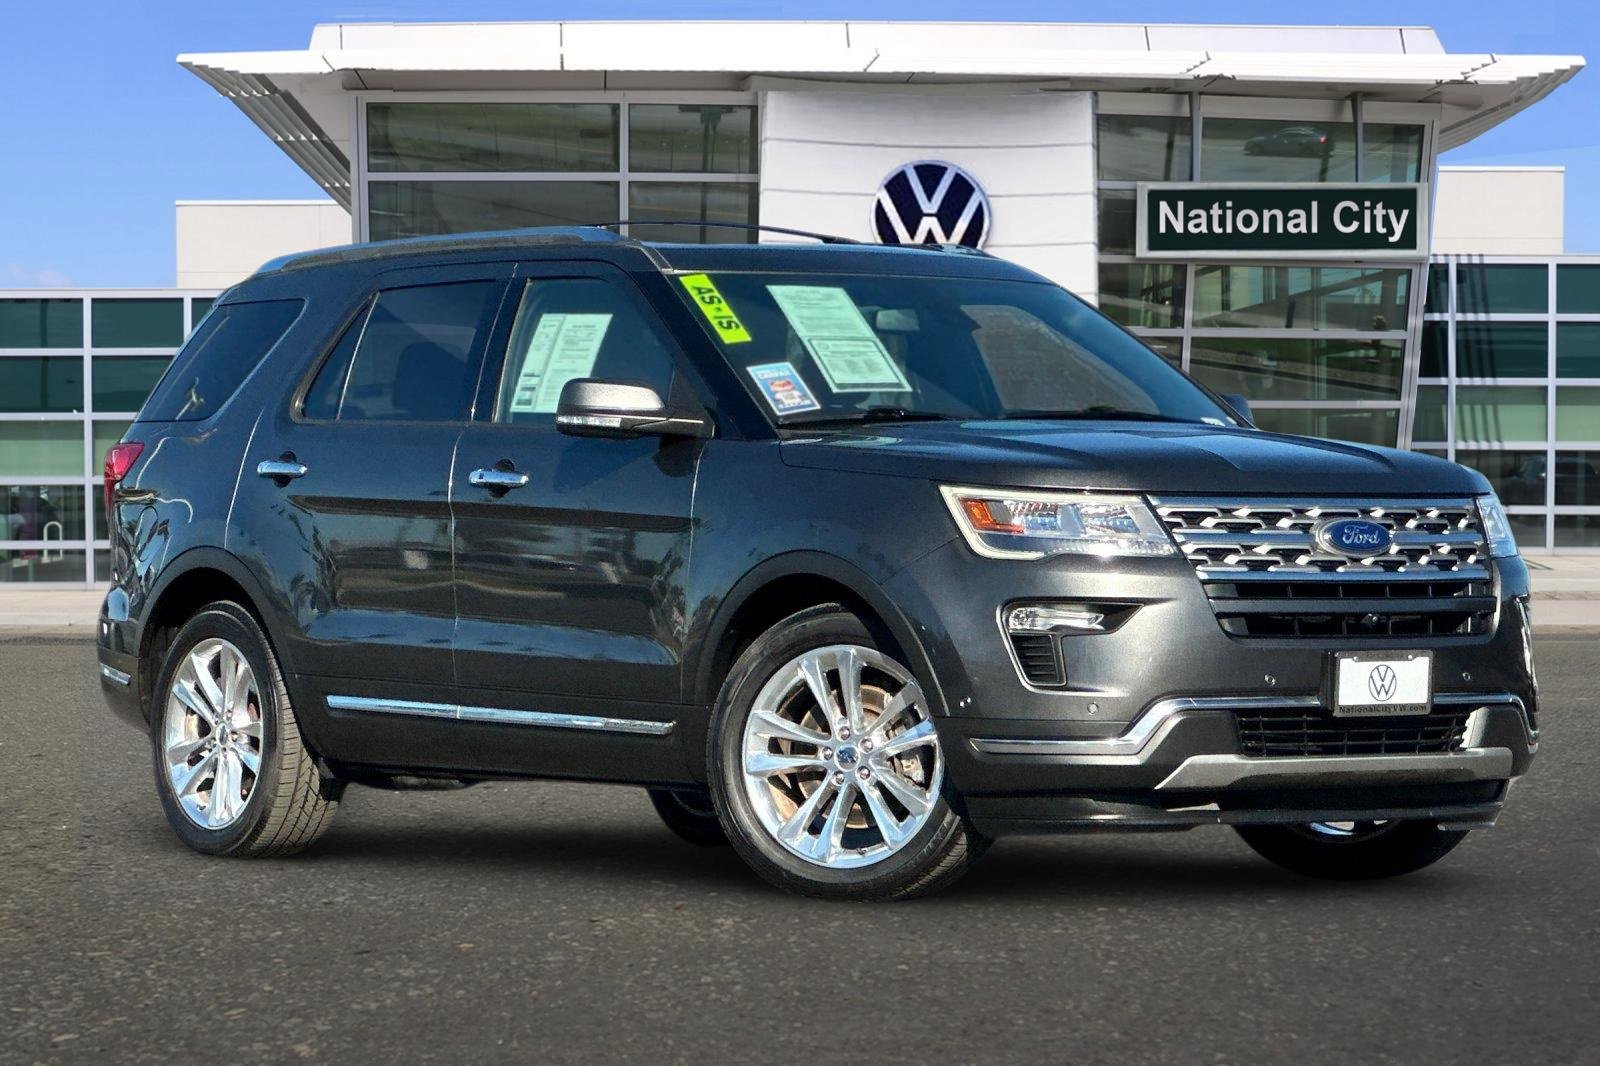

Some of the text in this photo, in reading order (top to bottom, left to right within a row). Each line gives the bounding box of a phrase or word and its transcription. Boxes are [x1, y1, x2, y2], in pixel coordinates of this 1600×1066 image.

[875, 164, 985, 245] VW
[1159, 200, 1409, 242] National City
[1342, 524, 1380, 544] Ford
